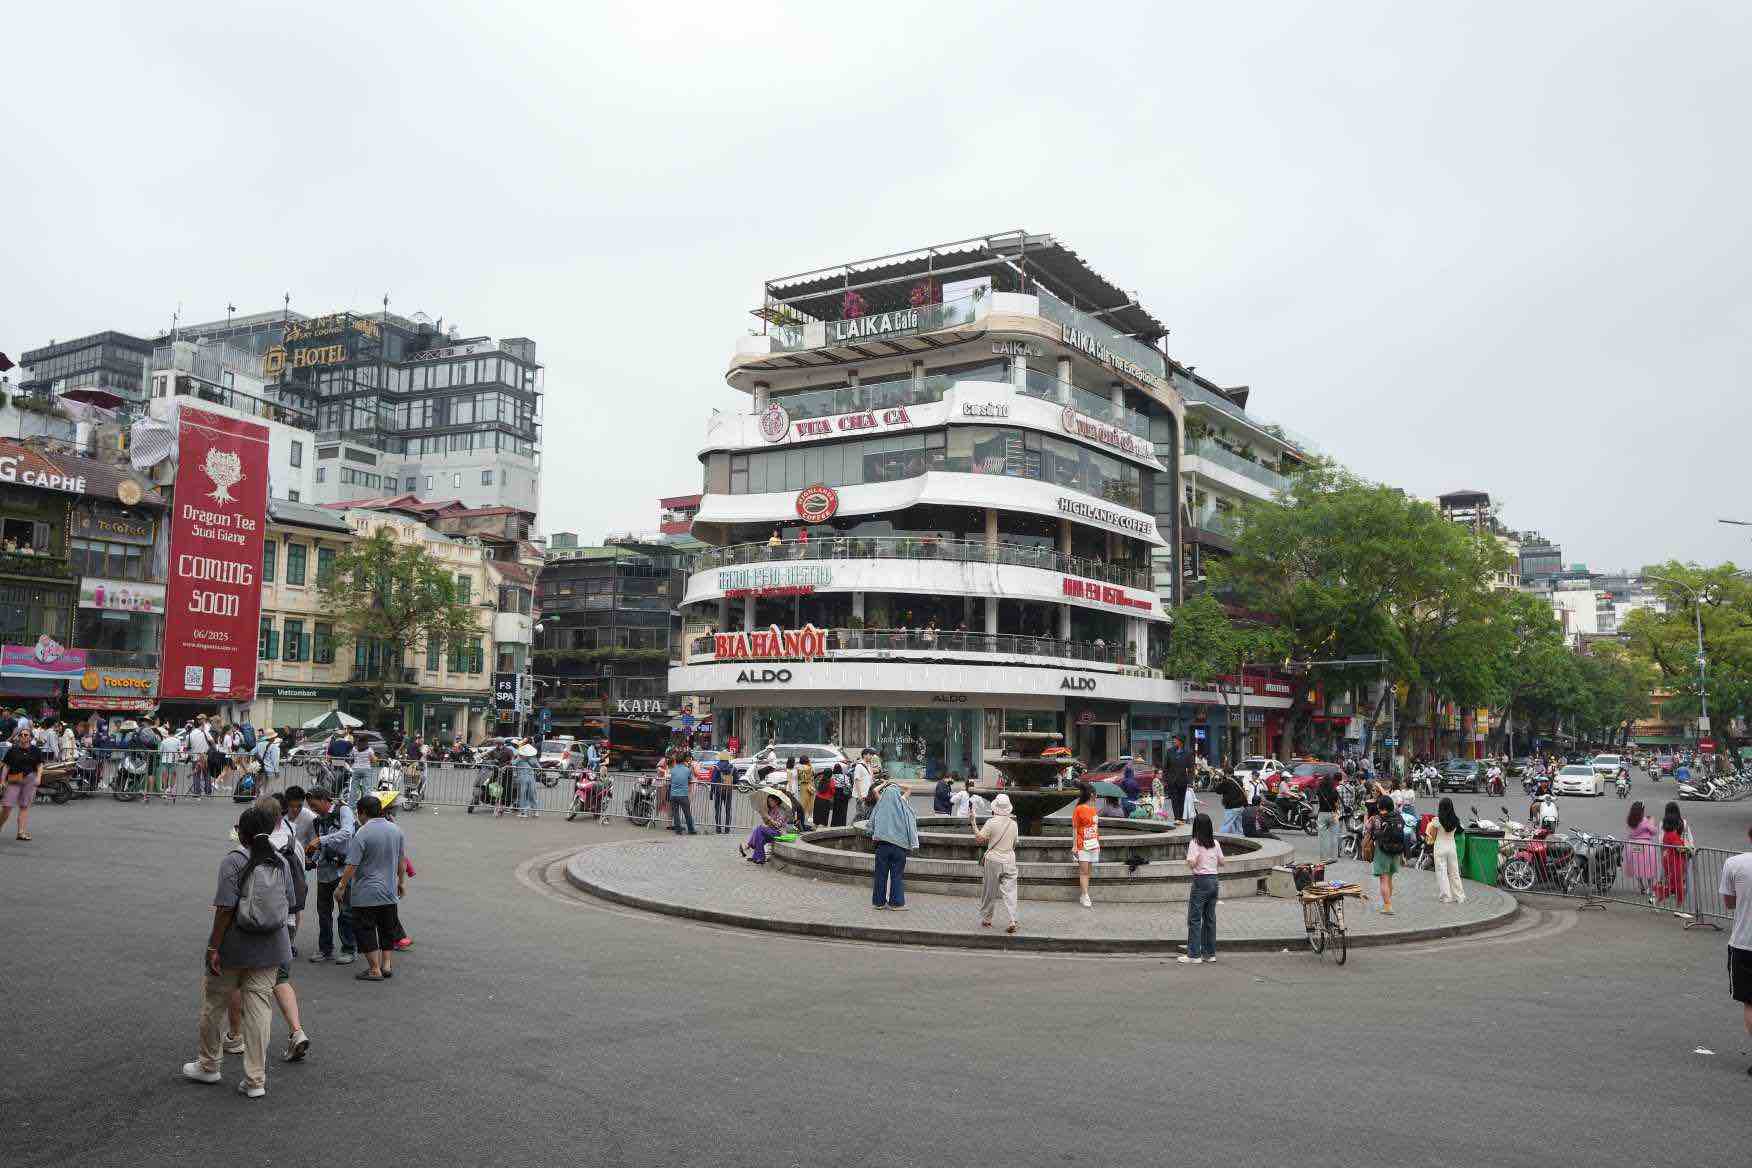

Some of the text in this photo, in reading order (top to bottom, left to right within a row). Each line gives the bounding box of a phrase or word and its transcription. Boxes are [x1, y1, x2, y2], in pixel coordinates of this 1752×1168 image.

[836, 310, 918, 341] LAIKA Café
[1061, 321, 1096, 357] LAIKA
[294, 344, 346, 368] HOTEL
[992, 342, 1030, 356] LAIKA
[796, 419, 832, 436] VUA
[183, 504, 256, 531] Dragon Tea
[1058, 498, 1152, 534] HIGHLANDS COFFEE
[178, 554, 253, 586] COMING
[188, 589, 240, 617] SOON
[714, 631, 750, 660] BIA
[784, 623, 826, 663] NỘI
[736, 668, 793, 683] ALDO
[1060, 676, 1097, 692] ALDO
[277, 688, 317, 697] Vietcombank
[499, 681, 512, 690] FS
[496, 692, 514, 701] SPA
[932, 694, 968, 703] ALDO
[617, 699, 662, 713] KAFA
